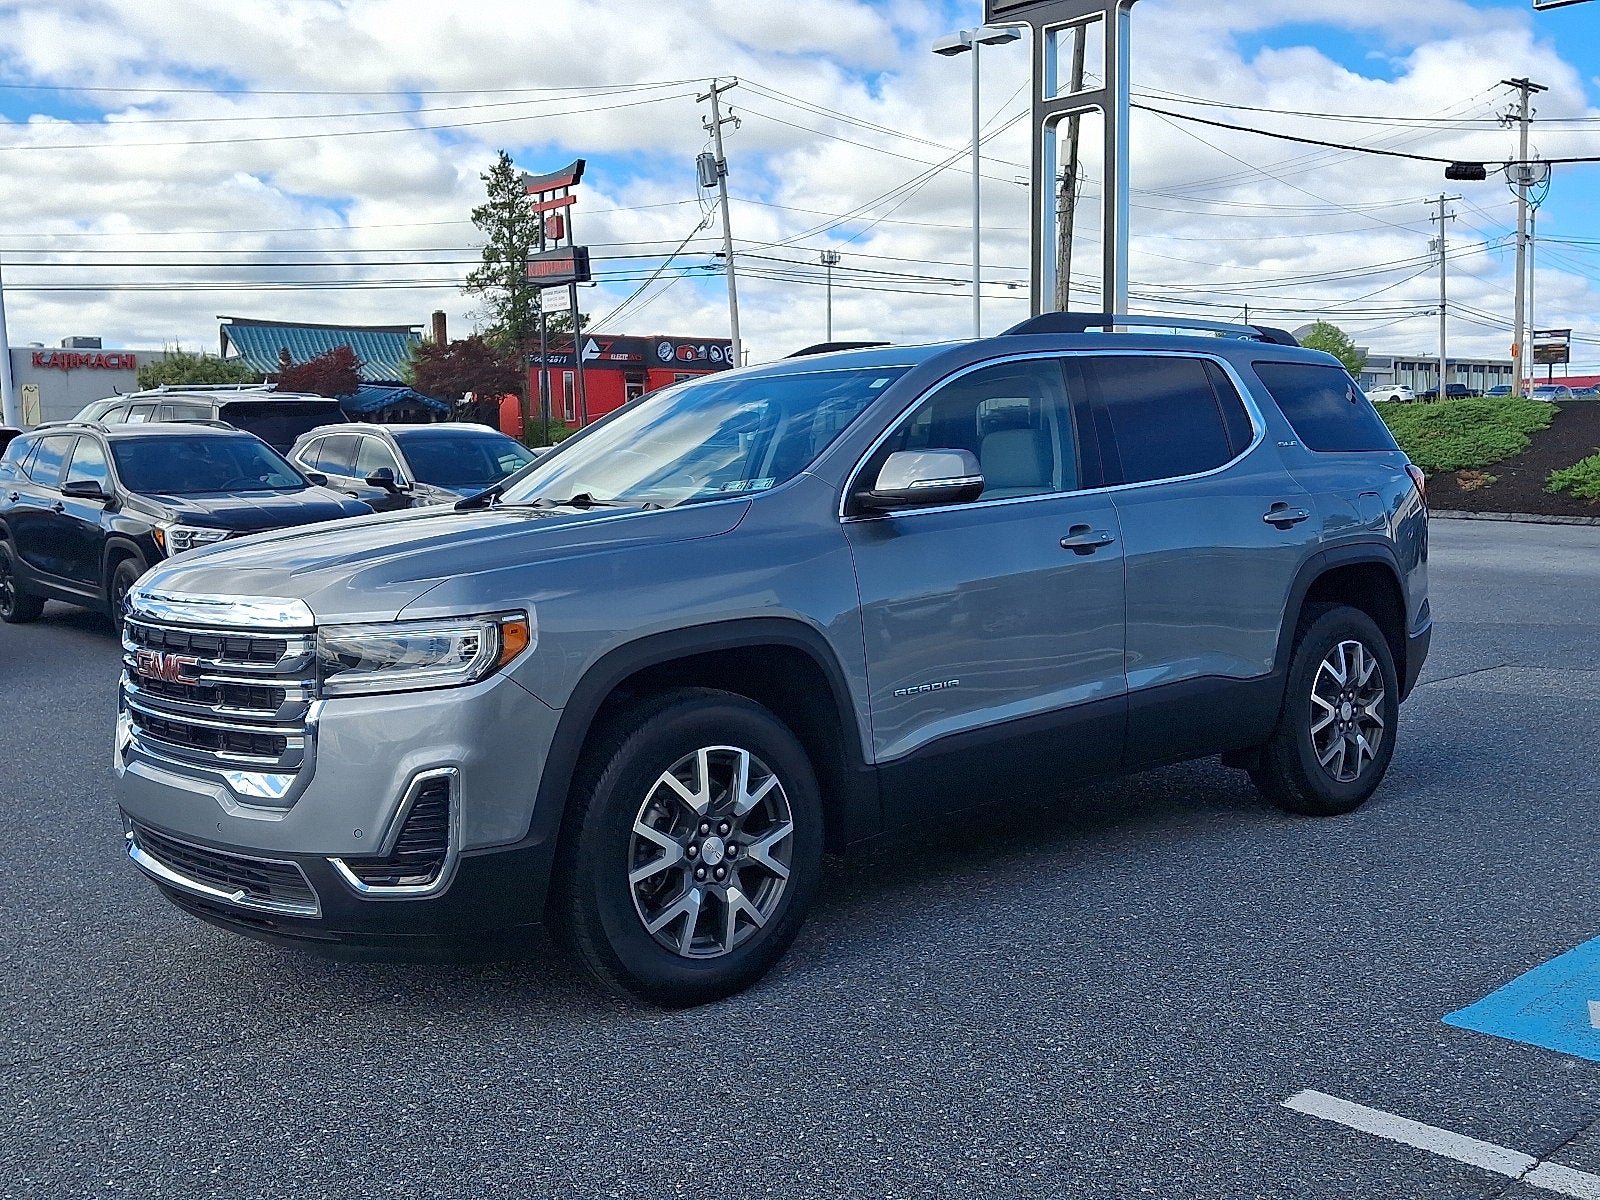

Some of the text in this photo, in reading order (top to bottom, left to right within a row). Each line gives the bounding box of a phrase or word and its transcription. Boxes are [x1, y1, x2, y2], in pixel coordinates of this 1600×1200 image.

[32, 352, 136, 370] KAJIMACHI
[137, 651, 201, 686] GMC
[894, 679, 960, 697] ACADIA
